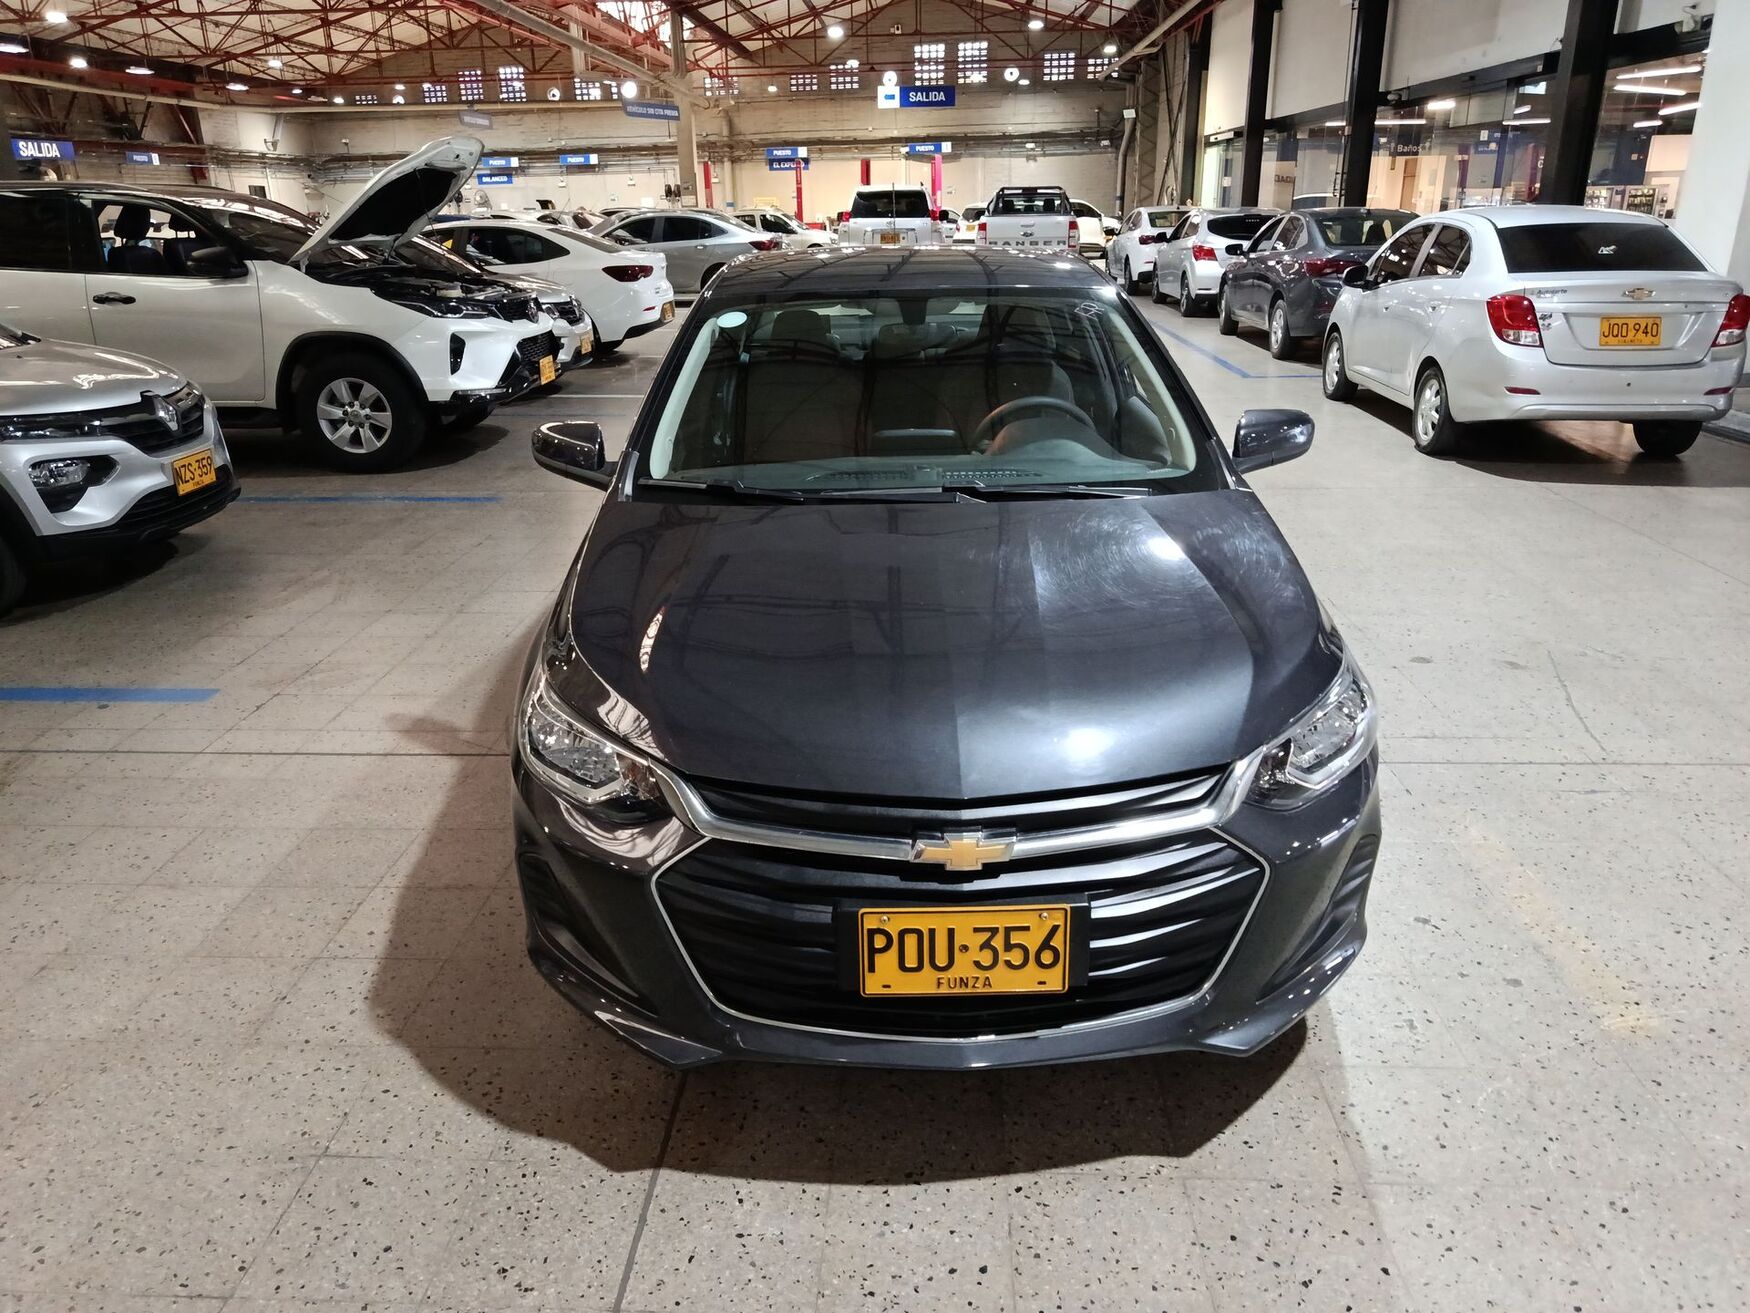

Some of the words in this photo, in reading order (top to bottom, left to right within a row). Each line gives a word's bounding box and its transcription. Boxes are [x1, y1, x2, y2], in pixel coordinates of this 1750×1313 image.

[909, 91, 946, 102] SALIDA
[19, 142, 60, 158] SALIDA
[1632, 322, 1659, 338] 940
[936, 975, 993, 989] FUNZA
